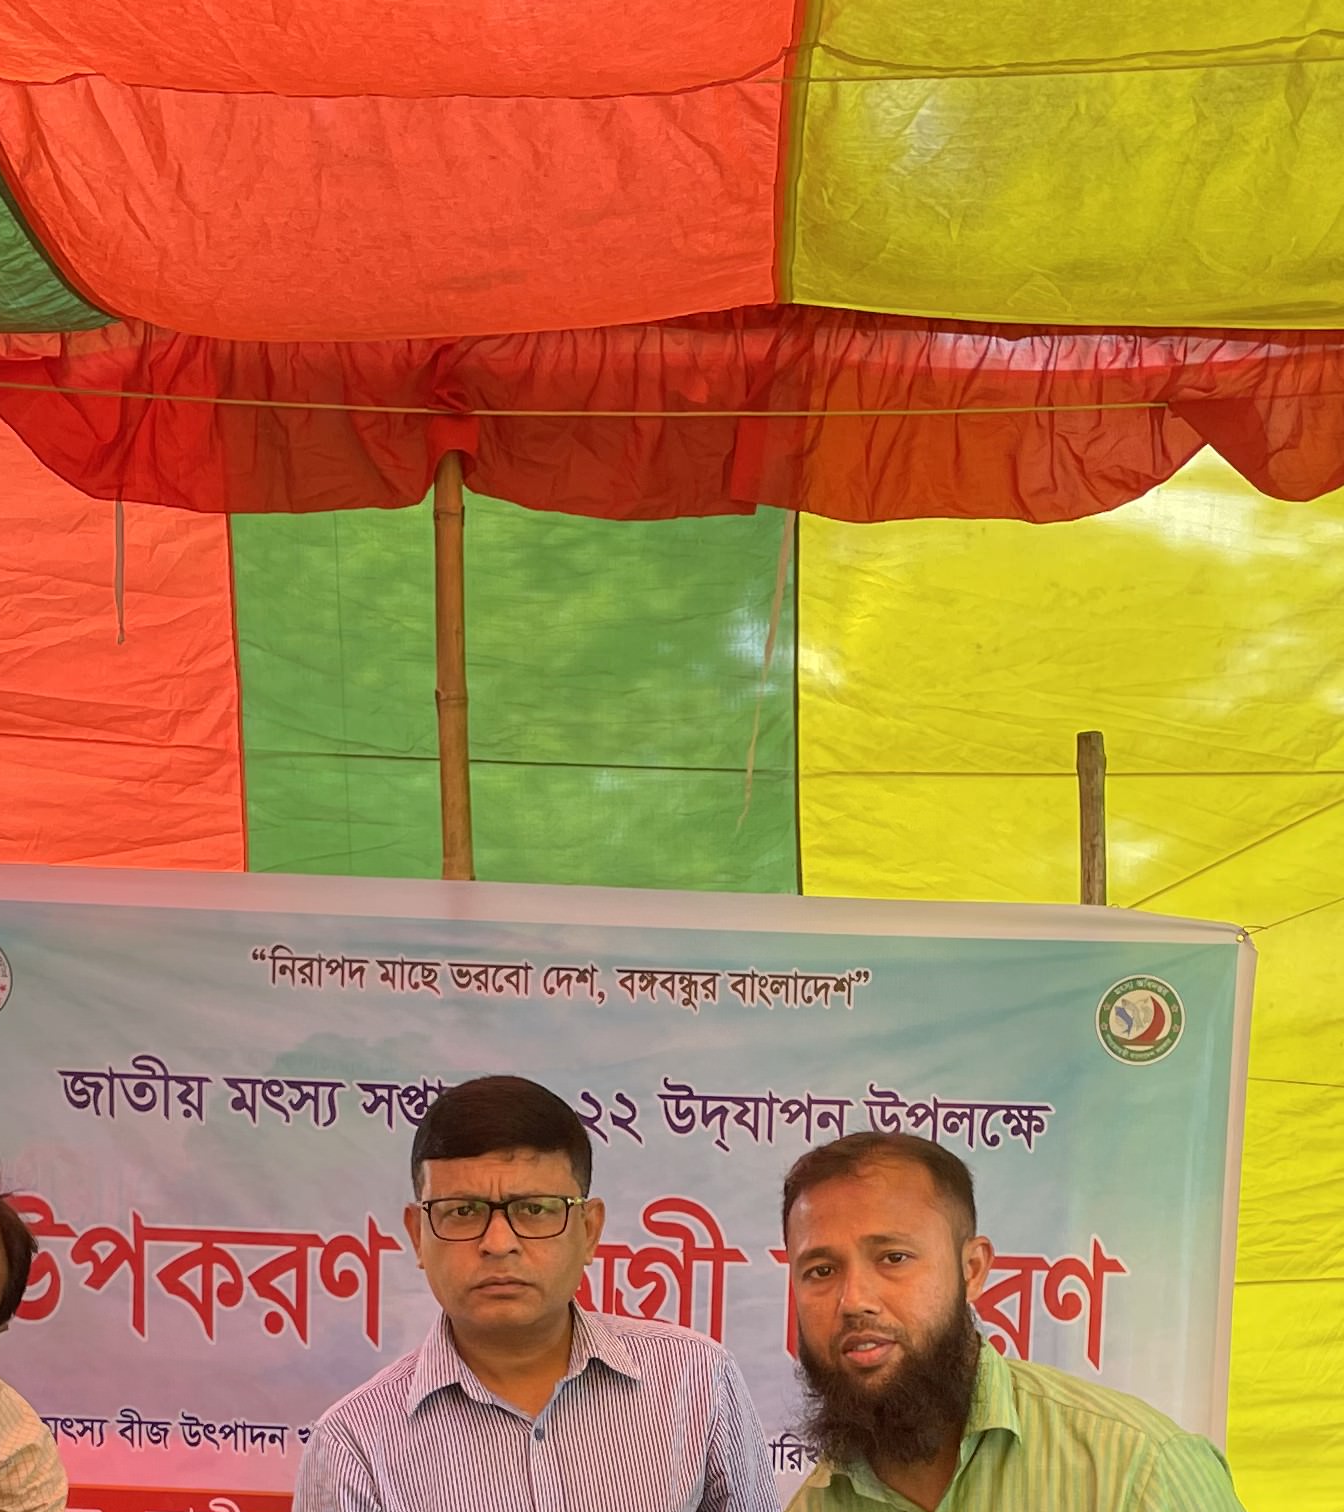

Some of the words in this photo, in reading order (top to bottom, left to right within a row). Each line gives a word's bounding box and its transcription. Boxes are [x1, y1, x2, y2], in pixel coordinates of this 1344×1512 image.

[251, 944, 369, 991] “নিরাপদ
[375, 954, 440, 994] মাছে
[449, 960, 534, 996] ভরবো
[543, 962, 606, 1004] দেশ,
[616, 965, 721, 1012] বঙ্গবন্ধুর
[728, 967, 872, 1008] বাংলাদেশ”
[57, 1054, 213, 1122] জাতীয়
[222, 1075, 346, 1127] মৎস্য
[861, 1082, 1052, 1150] উপলক্ষে
[115, 1408, 172, 1450] বীজ
[180, 1411, 290, 1455] উৎপাদন
